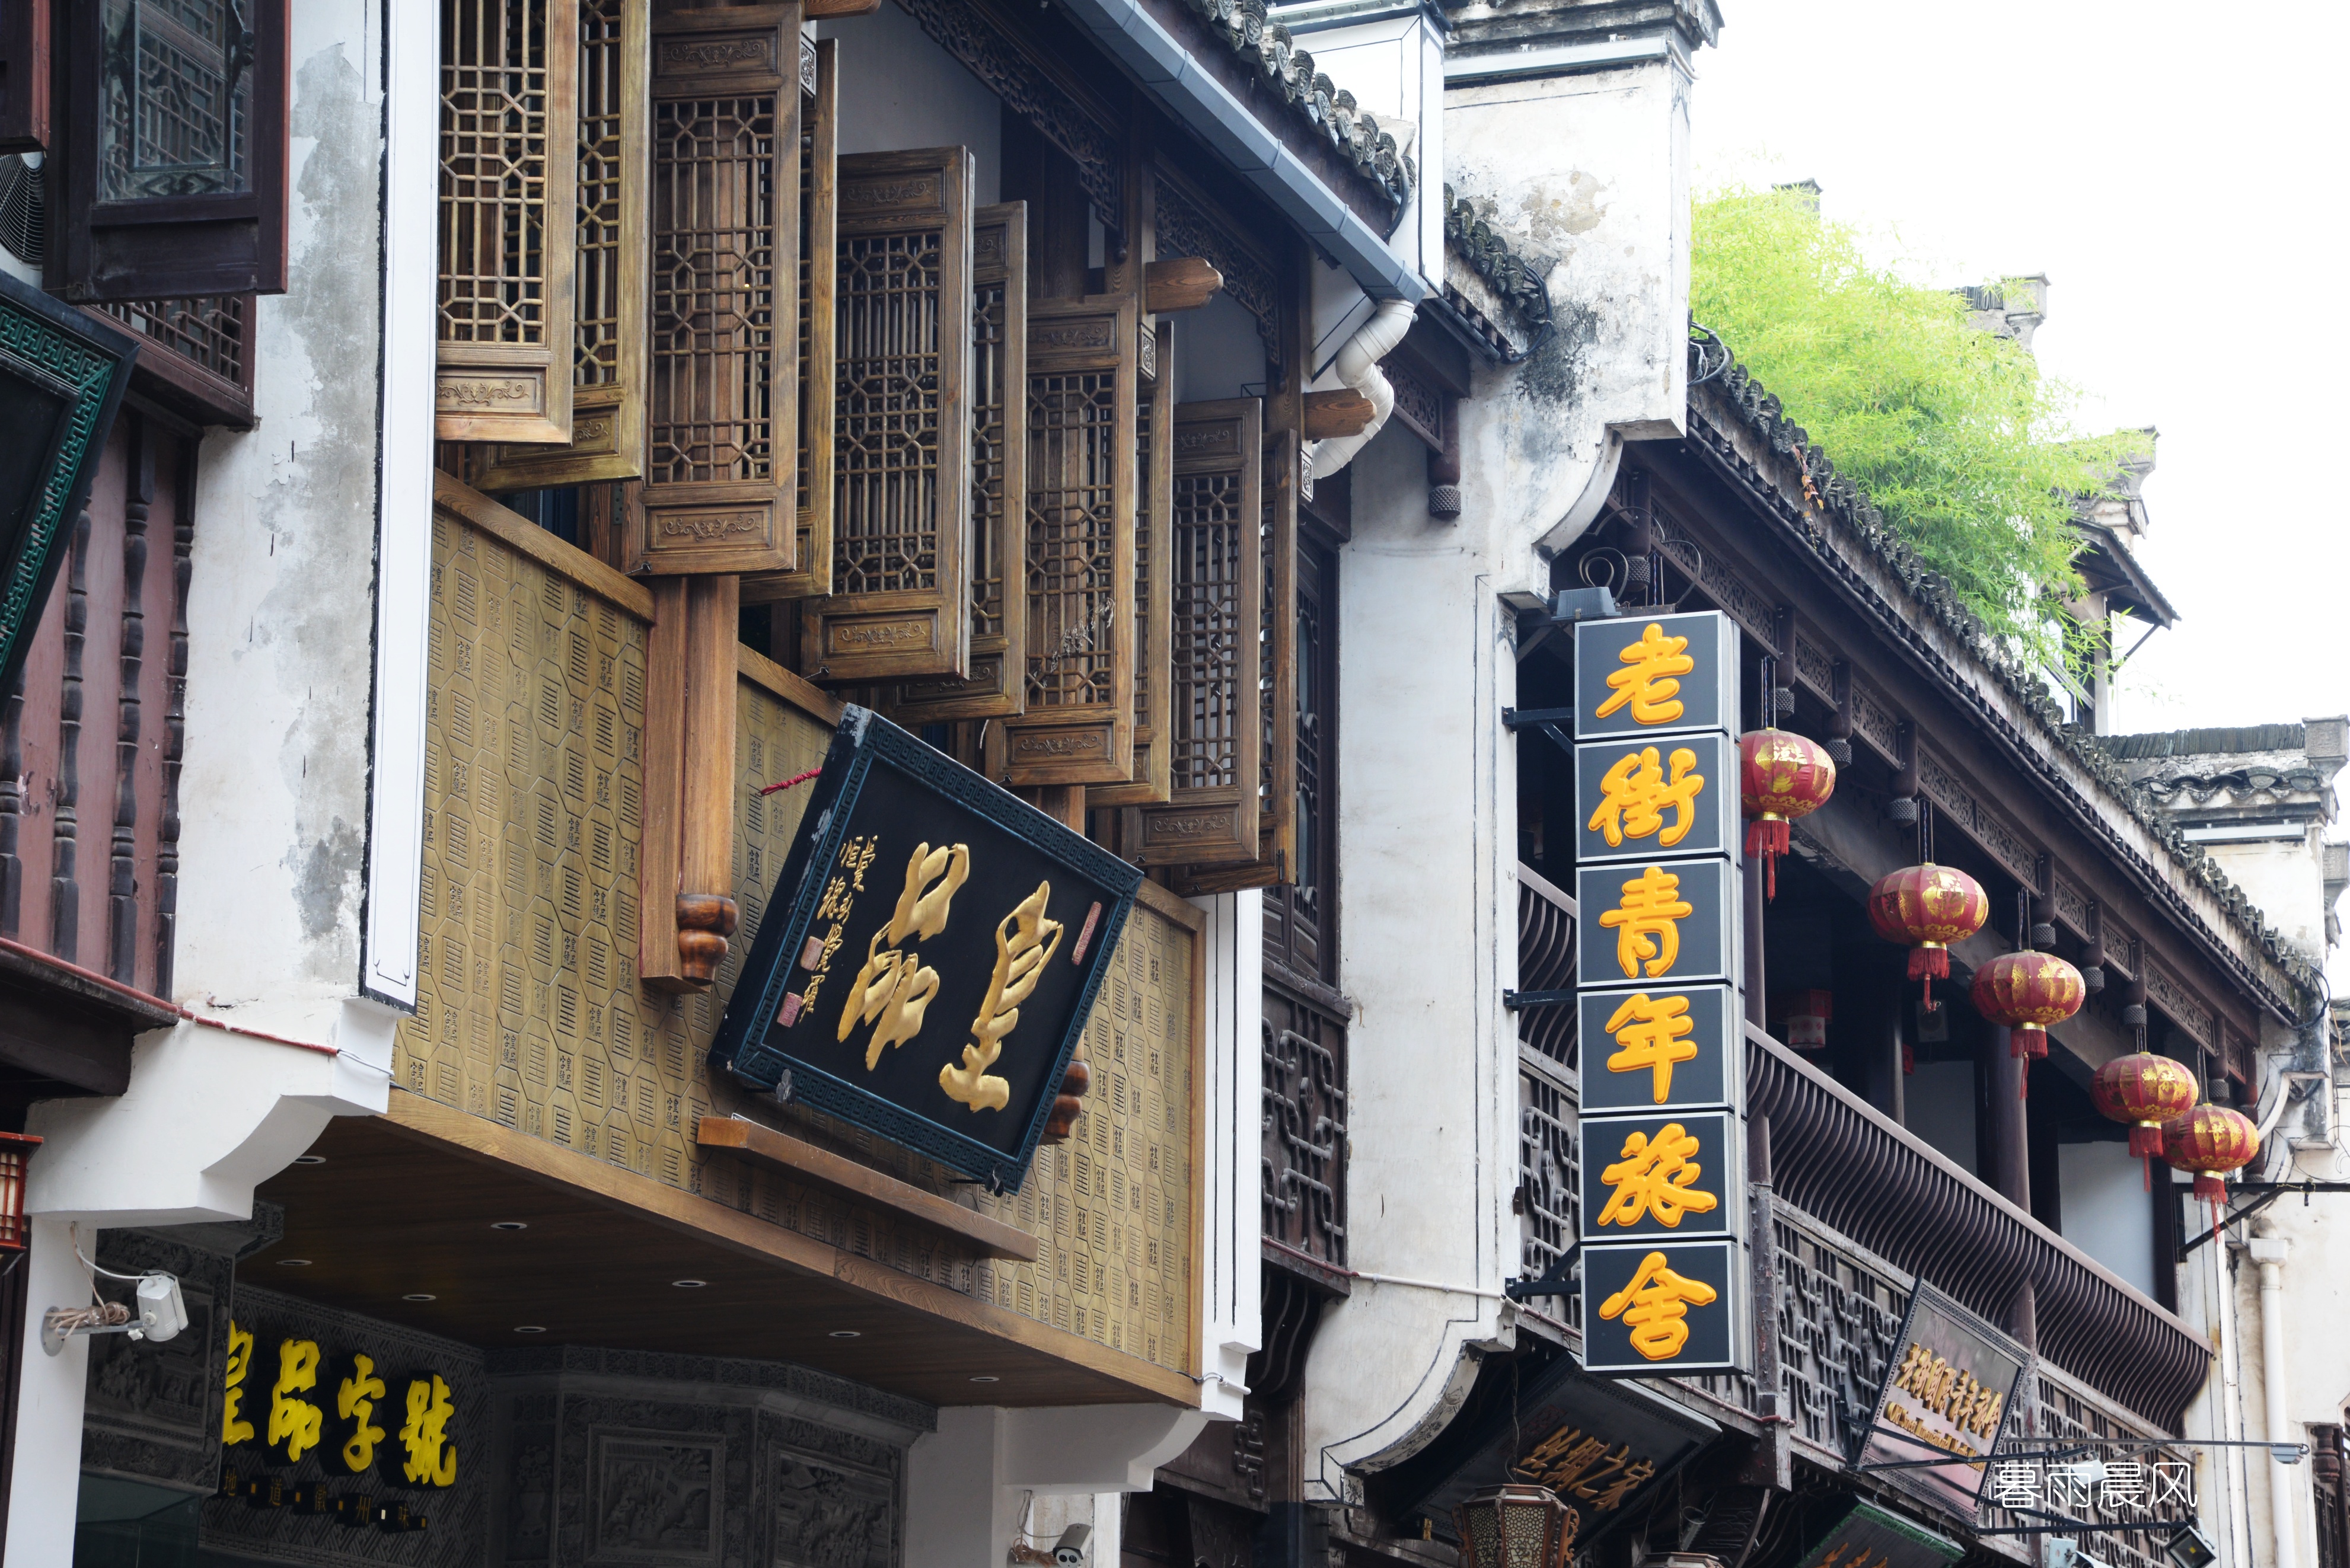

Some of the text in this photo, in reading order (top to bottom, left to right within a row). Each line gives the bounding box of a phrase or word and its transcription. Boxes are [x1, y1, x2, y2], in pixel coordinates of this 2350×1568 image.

[1589, 624, 1718, 1361] 老街青年旅舍
